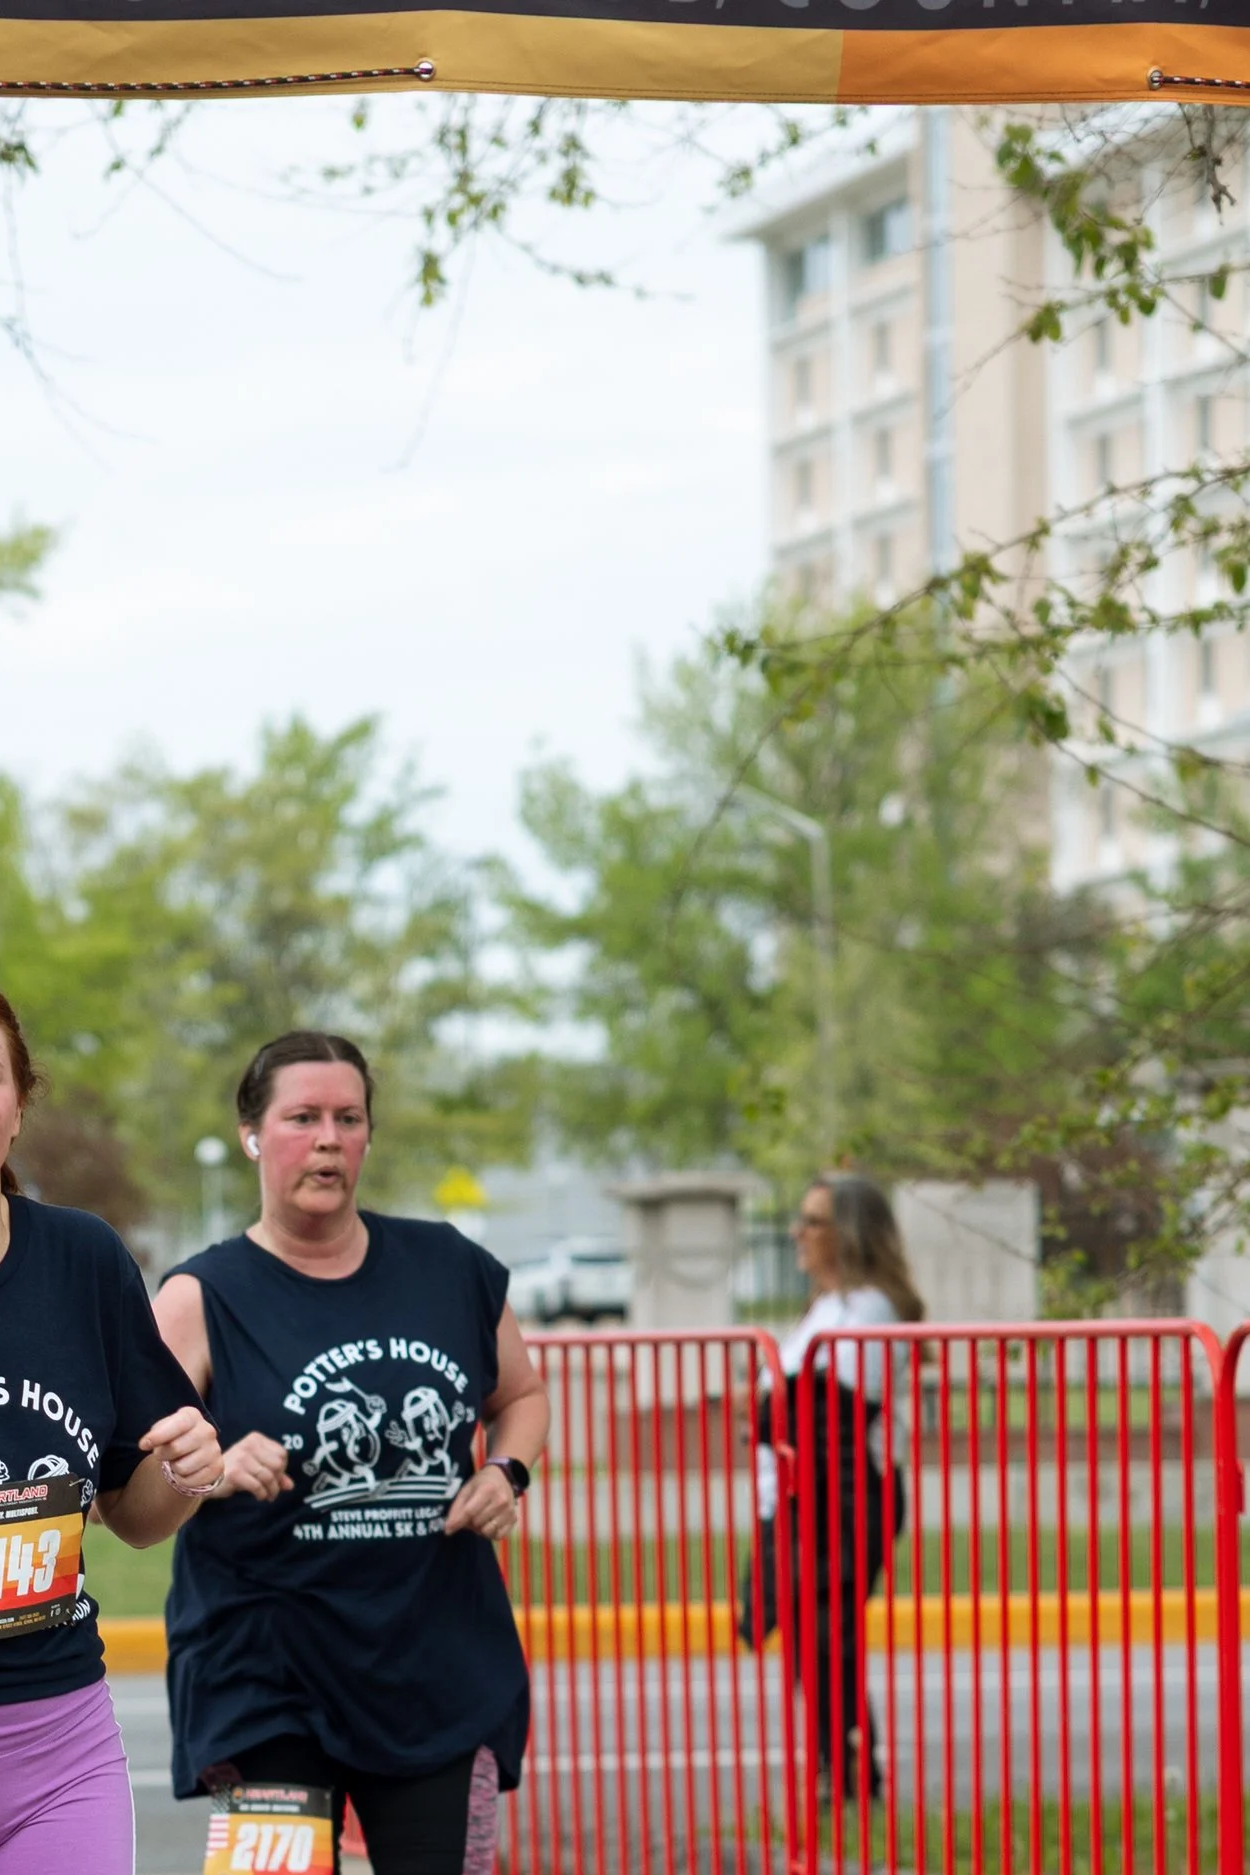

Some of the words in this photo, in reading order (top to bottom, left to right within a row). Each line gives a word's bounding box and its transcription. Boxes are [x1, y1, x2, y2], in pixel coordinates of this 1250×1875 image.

[283, 1337, 383, 1415] POTTER'S
[389, 1337, 468, 1394] HOUSE
[21, 1379, 99, 1469] HOUSE
[281, 1434, 304, 1450] 20
[292, 1523, 324, 1541] 4TH
[327, 1522, 393, 1540] ANNUAL
[330, 1509, 363, 1523] STEVE
[229, 1821, 315, 1873] 2170
